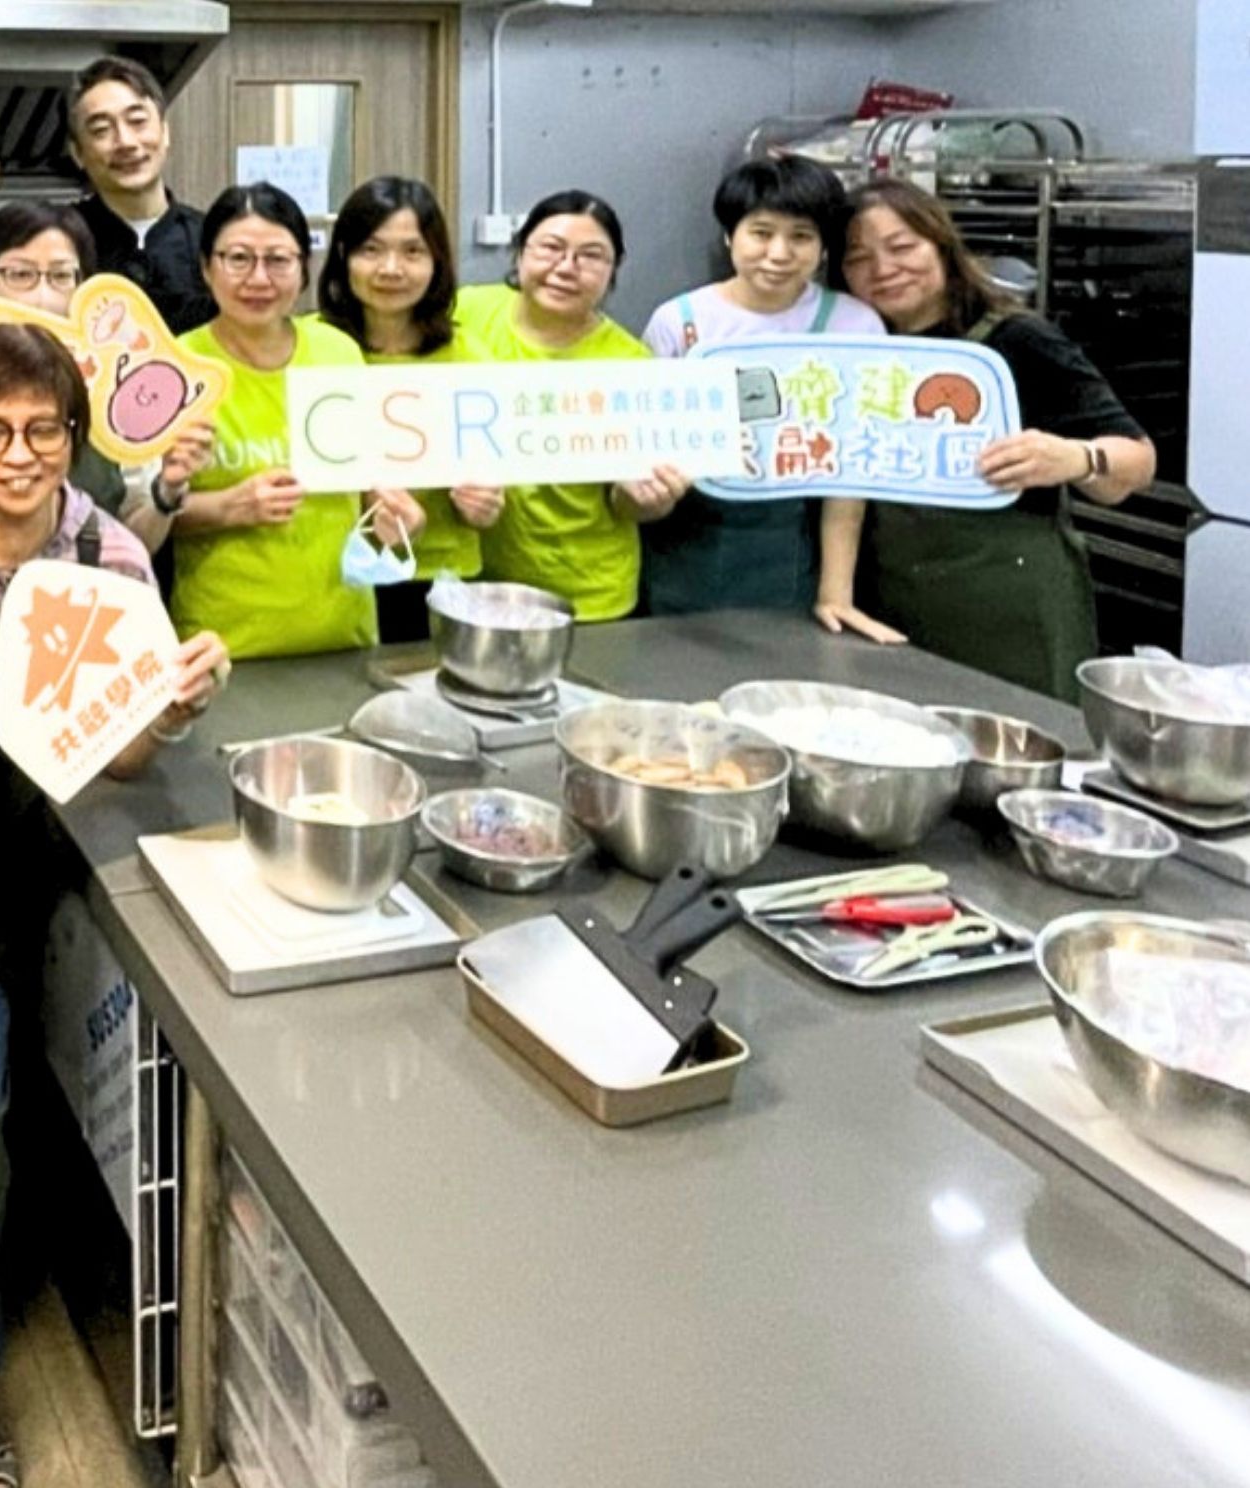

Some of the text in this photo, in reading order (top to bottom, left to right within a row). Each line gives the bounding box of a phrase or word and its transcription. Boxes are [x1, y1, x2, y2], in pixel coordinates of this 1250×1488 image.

[515, 425, 727, 455] Committee
[51, 649, 165, 764] 共融學院
